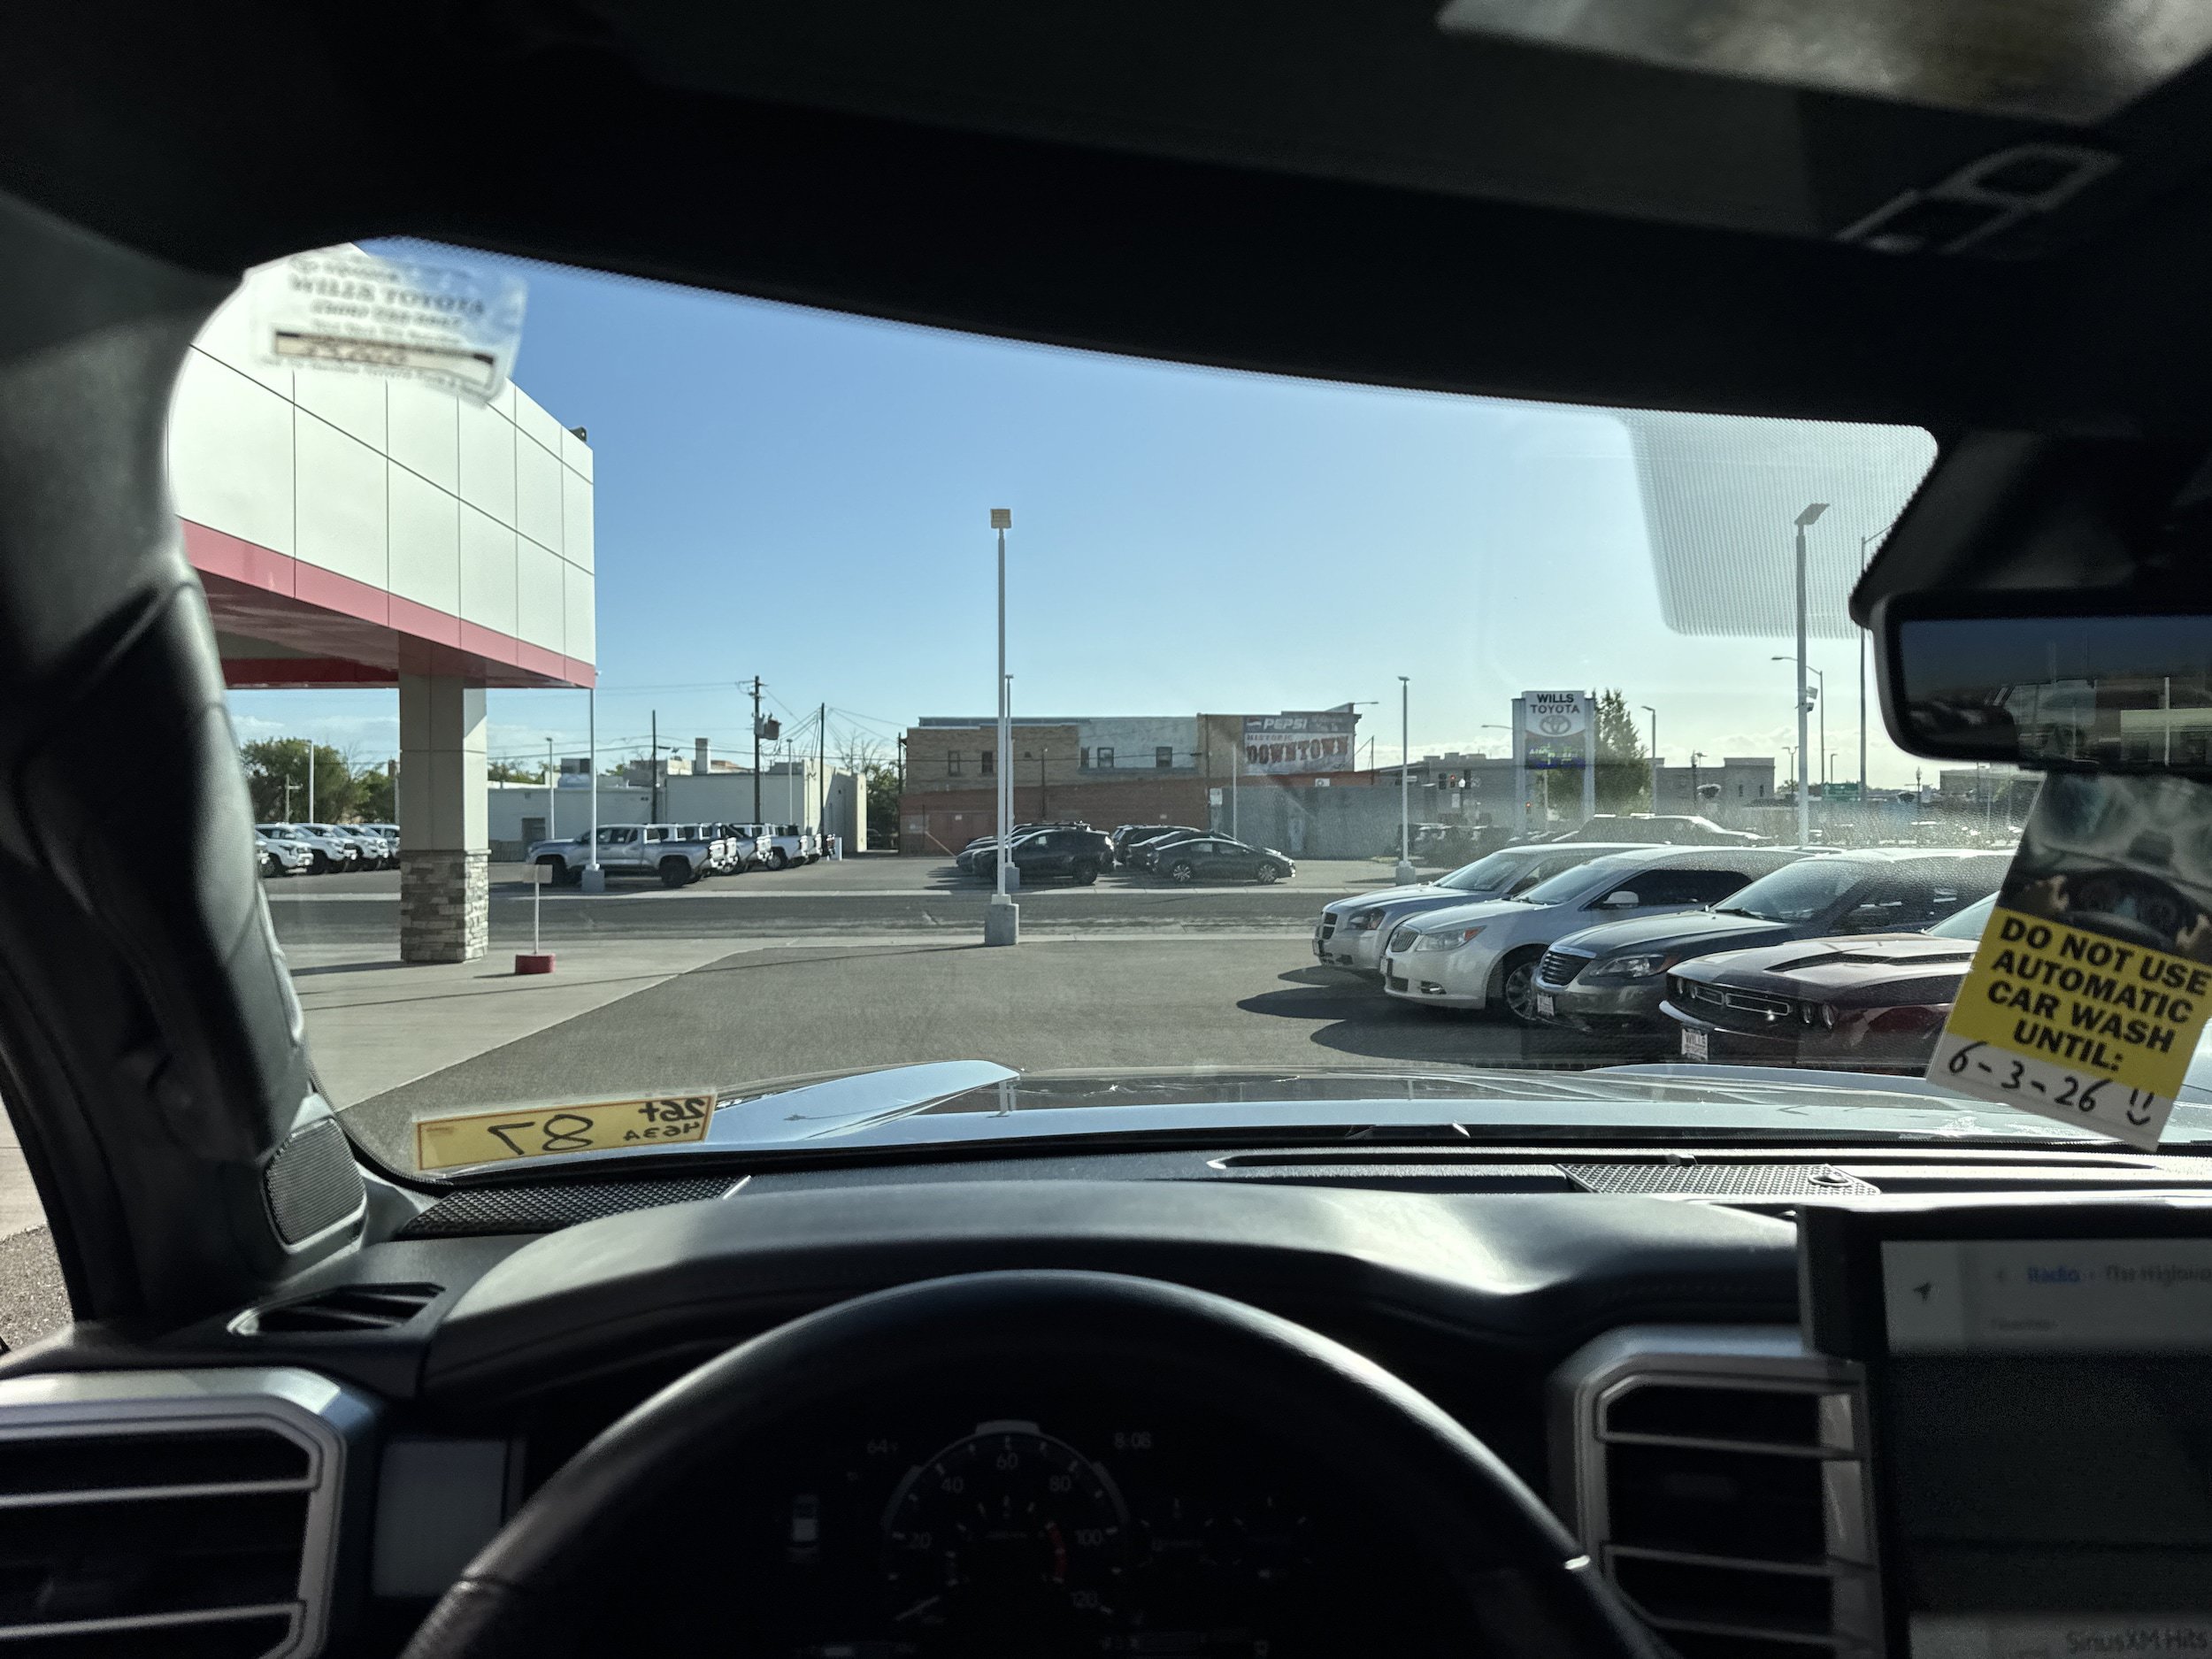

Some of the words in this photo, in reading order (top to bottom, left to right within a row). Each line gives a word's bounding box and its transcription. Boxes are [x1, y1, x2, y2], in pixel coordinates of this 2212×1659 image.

[1537, 694, 1574, 703] WILLS
[1531, 704, 1580, 714] TOYOTA
[1263, 718, 1308, 730] PEPSI
[1246, 736, 1348, 764] DOWNTOWN
[2000, 917, 2052, 949] DO
[2059, 933, 2134, 972] NOT
[2139, 955, 2211, 996] USE
[1991, 949, 2193, 1024] AUTOMATIC
[1988, 980, 2061, 1020] CAR
[2071, 1002, 2176, 1053] WASH
[2014, 1019, 2124, 1071] UNTIL:
[2027, 1265, 2080, 1283] Radio
[995, 1453, 1018, 1471] 60
[940, 1477, 964, 1494] 40
[1048, 1475, 1072, 1493] 80
[1074, 1528, 1103, 1547] 100
